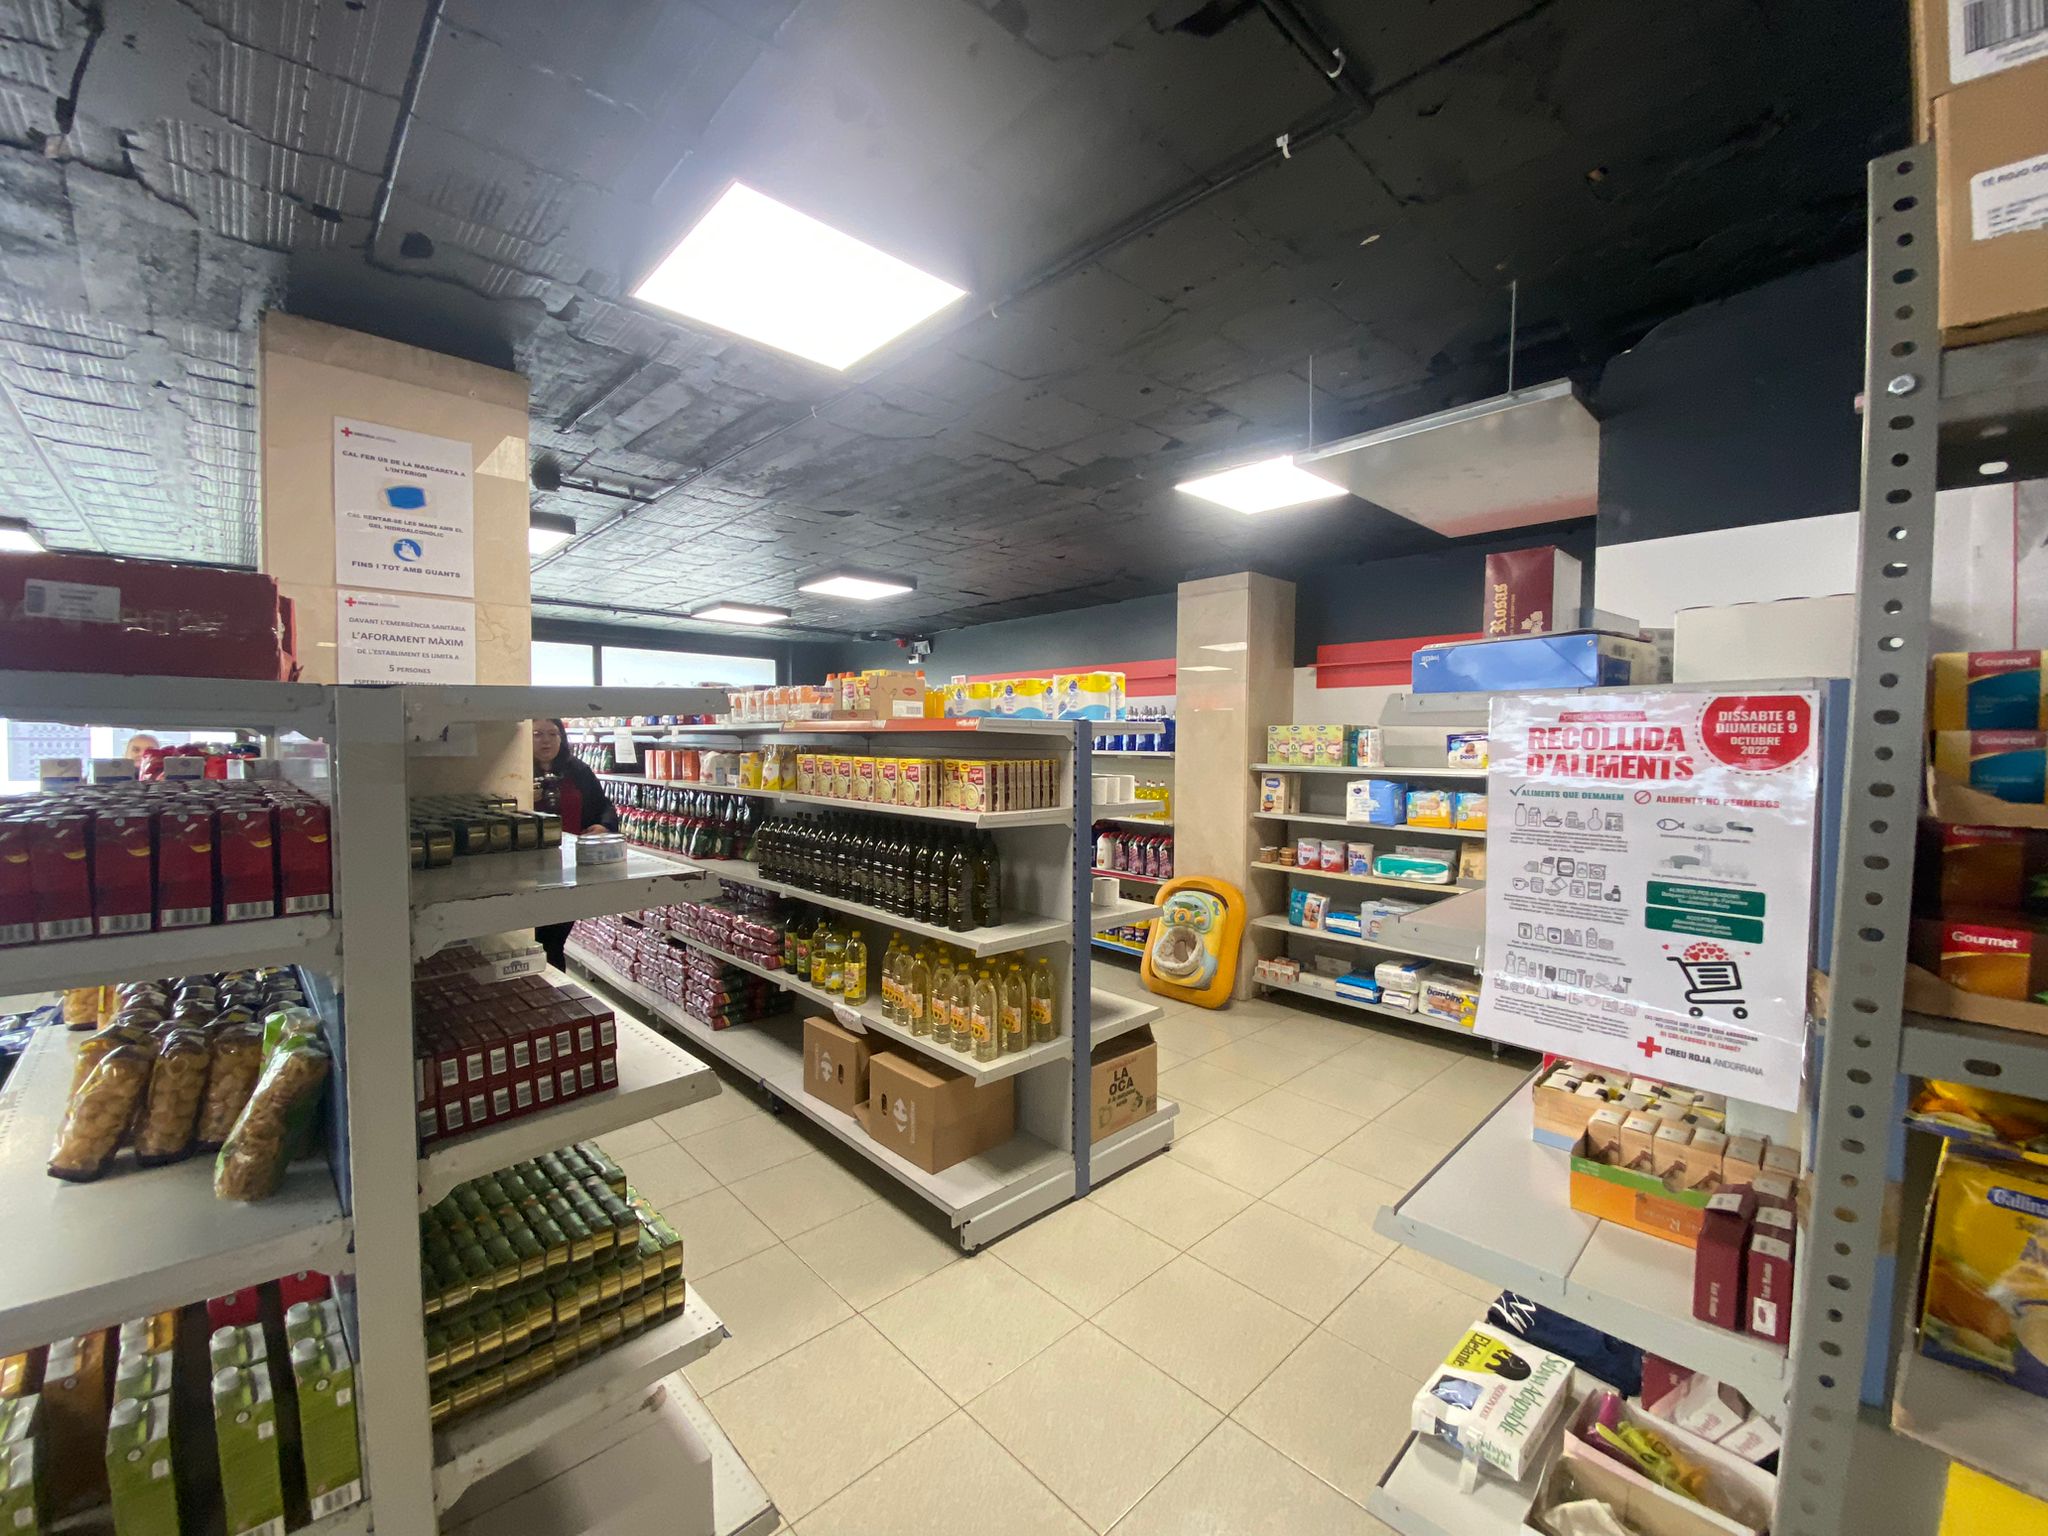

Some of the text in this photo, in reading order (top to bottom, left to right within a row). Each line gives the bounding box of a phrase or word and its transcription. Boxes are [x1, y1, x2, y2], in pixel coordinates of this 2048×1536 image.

[342, 450, 358, 458] CAL
[360, 453, 375, 461] FER
[414, 463, 458, 476] MASCARETA
[385, 466, 427, 478] L'INTERIOR
[352, 560, 374, 568] FINS
[403, 566, 422, 574] AMB
[425, 568, 461, 578] GUANTS
[349, 616, 379, 625] DAVANT
[352, 631, 464, 647] L'AFORAMENT MÀXIM
[388, 664, 395, 672] 5
[1975, 655, 2031, 668] Gourmet
[1718, 711, 1796, 722] DISSABTE 8
[1716, 723, 1798, 734] DIUMENGE 9
[1528, 727, 1686, 751] RECOLLIDA
[1730, 736, 1781, 746] OCTUBRE
[1977, 733, 2037, 747] Gourmet
[1740, 746, 1769, 755] 2022
[1527, 753, 1694, 781] D'ALIMENTS
[1521, 789, 1624, 801] ALIMENTS QUE DEMANEM
[1951, 930, 2018, 949] Gourmet
[1426, 985, 1465, 1004] bambino
[1665, 1047, 1764, 1076] CREU ROJA ANDORRANA
[1113, 1067, 1128, 1082] LA
[1109, 1077, 1134, 1096] OCA
[1453, 1332, 1493, 1369] Elefante
